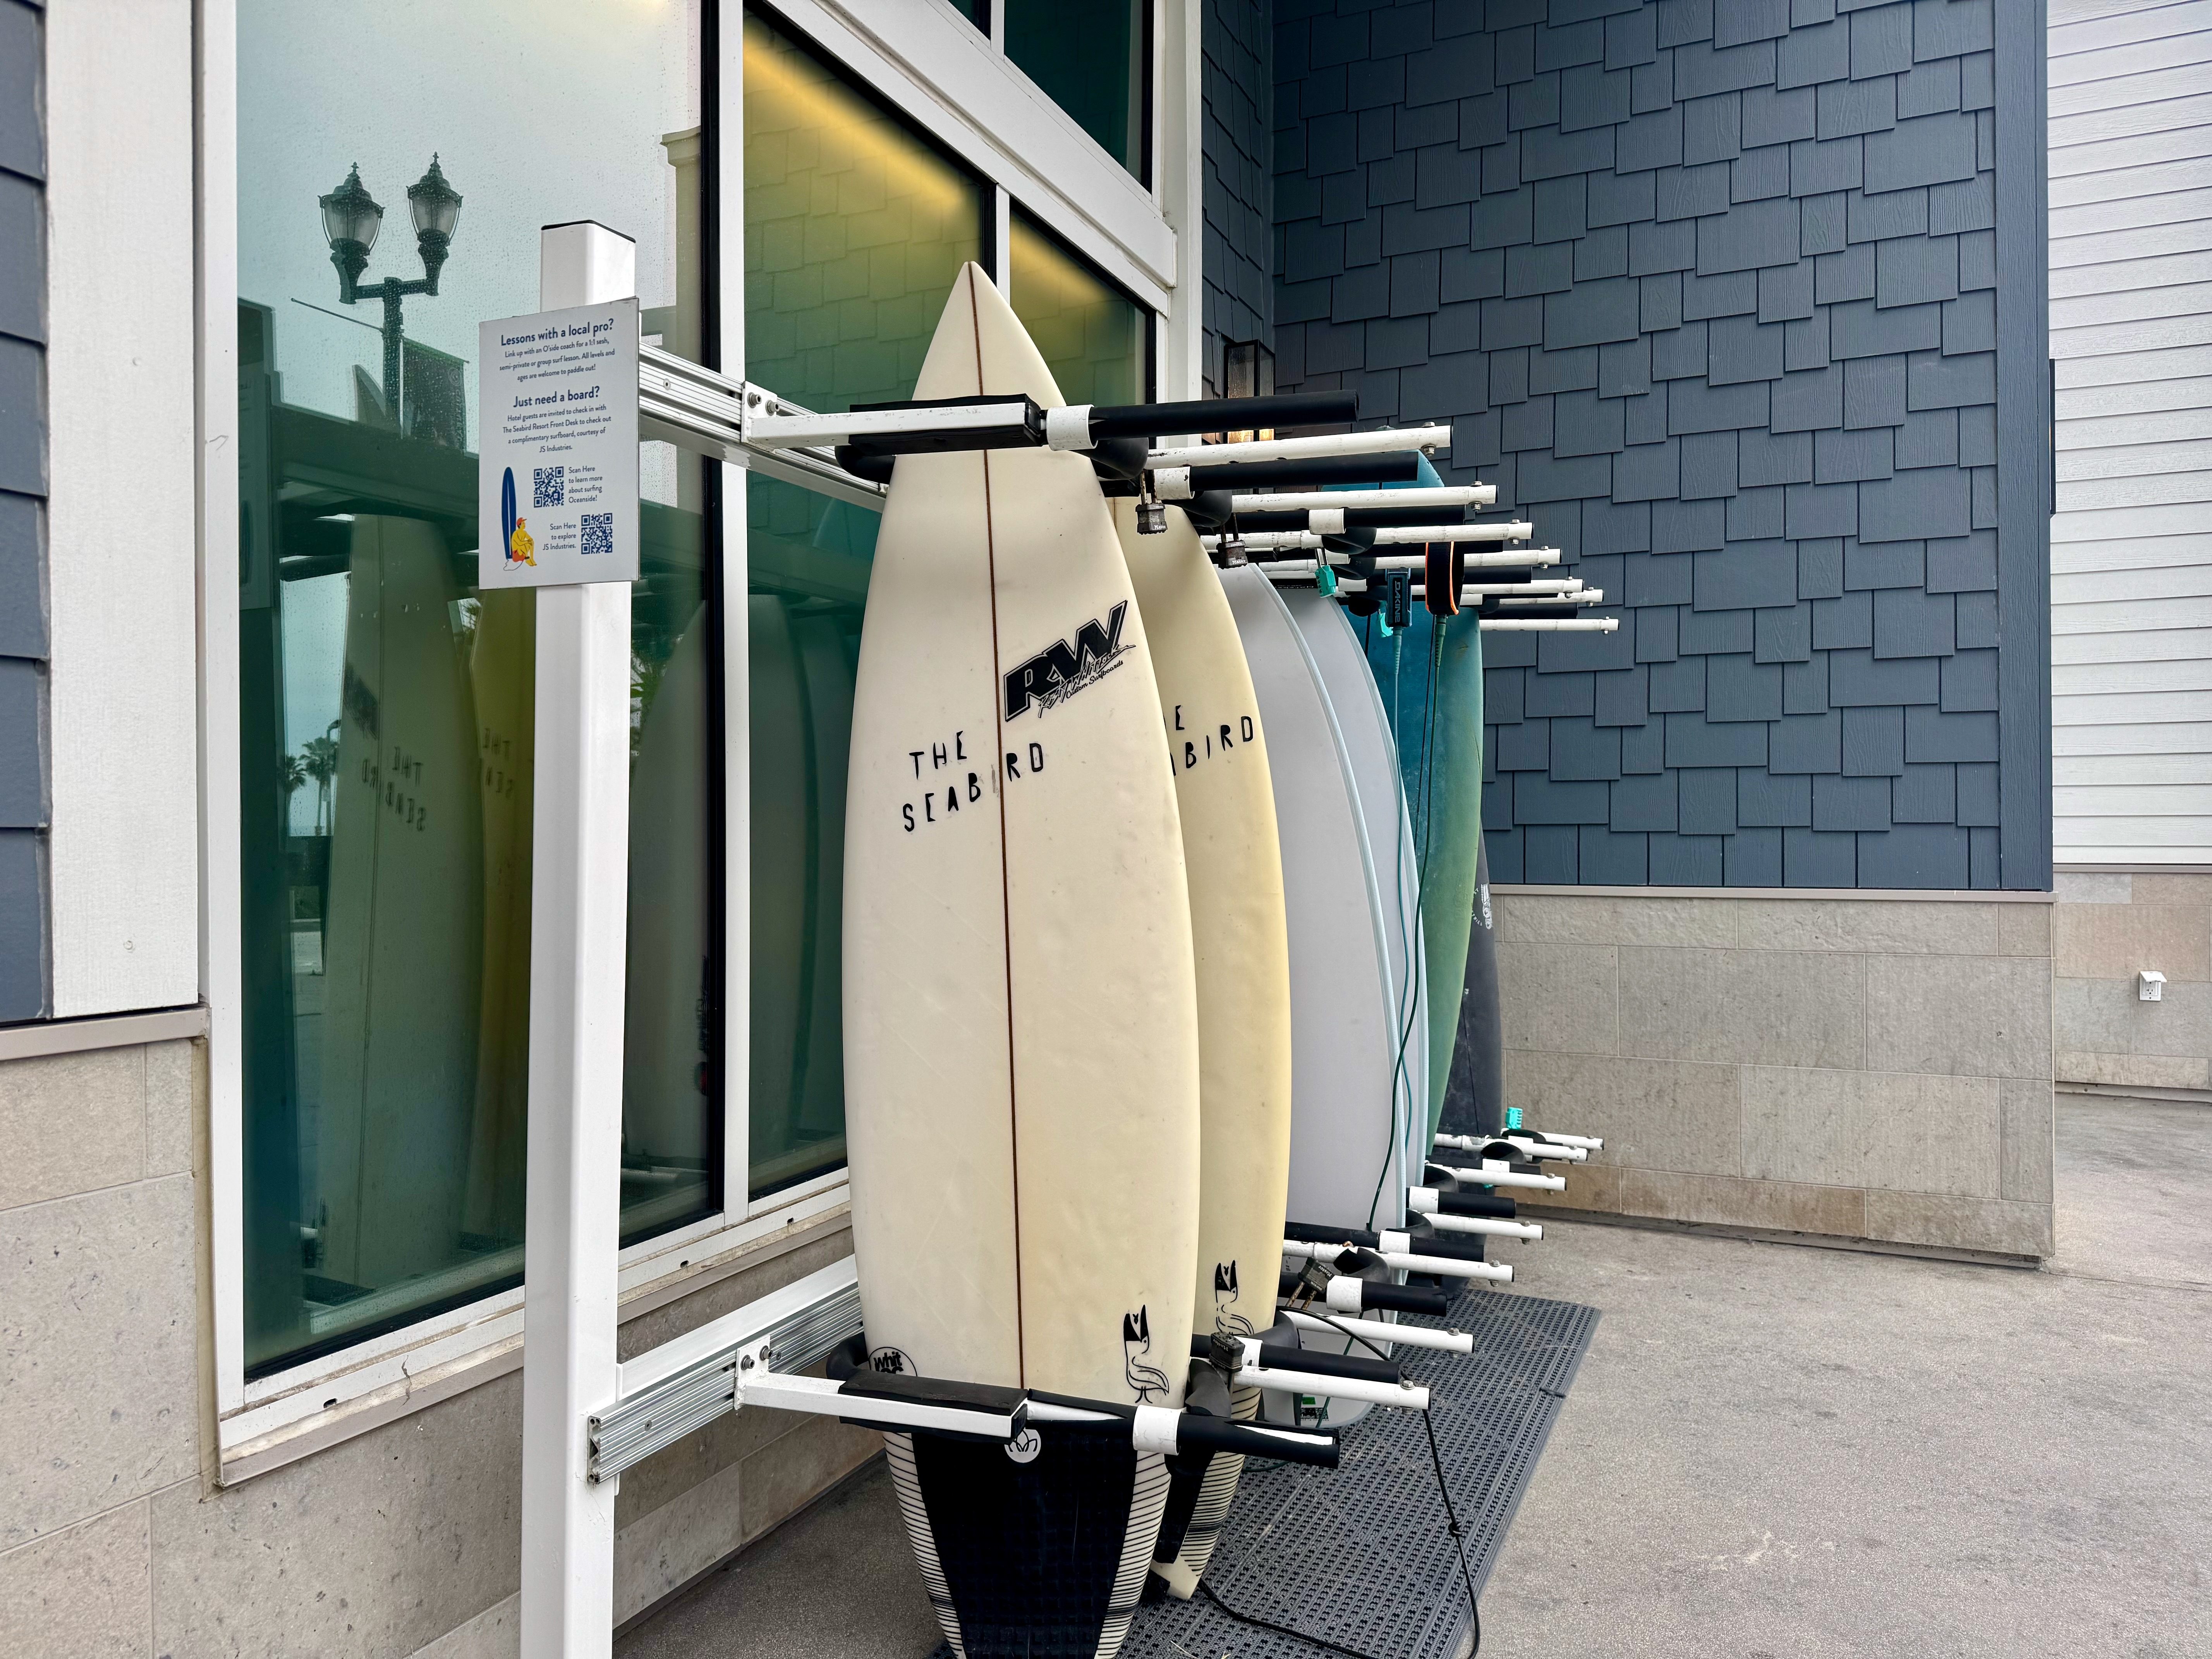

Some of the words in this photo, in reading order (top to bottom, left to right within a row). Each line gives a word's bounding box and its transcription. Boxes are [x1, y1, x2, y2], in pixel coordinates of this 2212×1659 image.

[501, 335, 535, 346] Lessons
[538, 327, 558, 340] with
[569, 321, 589, 336] local
[593, 318, 614, 337] pro?
[543, 344, 559, 352] O'side
[500, 362, 529, 371] semi-private
[537, 359, 551, 368] group
[567, 366, 584, 376] paddle
[513, 395, 532, 407] Just
[535, 391, 557, 405] need
[568, 385, 599, 401] board?
[522, 413, 538, 422] guests
[548, 409, 565, 417] invited
[573, 406, 587, 414] check
[513, 424, 531, 432] Seabird
[586, 416, 601, 424] check
[512, 435, 549, 444] complimentary
[550, 430, 575, 439] surfboard,
[584, 485, 602, 493] surfing
[568, 495, 597, 503] Oceanside!
[558, 532, 576, 541] explore
[1003, 599, 1128, 723] RW
[1066, 682, 1088, 699] Custom
[1089, 660, 1123, 685] Surfboards
[1170, 716, 1253, 776] BIRD
[909, 730, 967, 780] THE
[874, 1351, 902, 1368] whit
